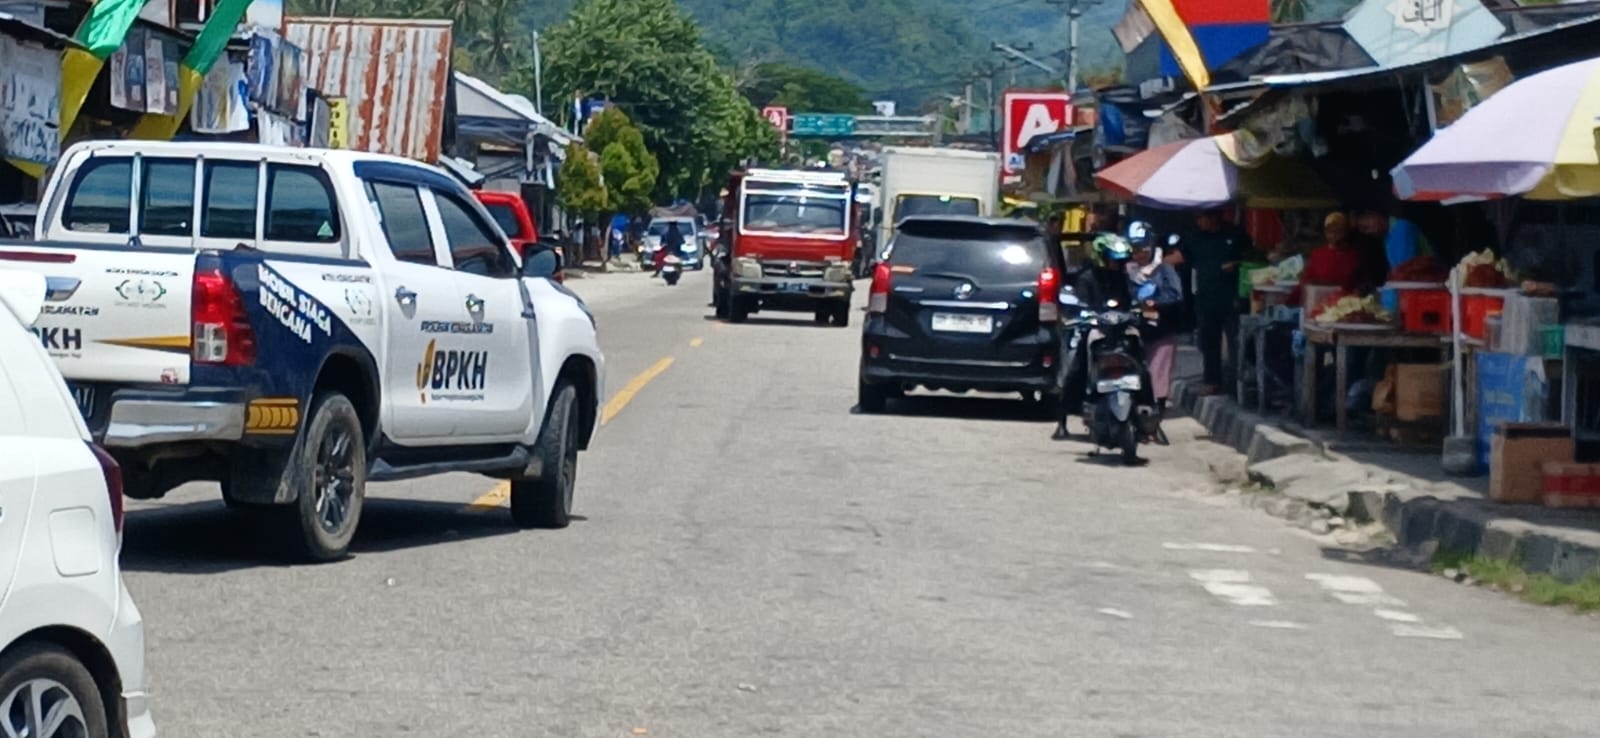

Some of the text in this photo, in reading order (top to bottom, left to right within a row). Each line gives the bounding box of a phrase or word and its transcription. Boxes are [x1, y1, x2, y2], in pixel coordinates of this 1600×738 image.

[257, 263, 332, 337] MOBIL SIAGA
[259, 285, 312, 344] BENCANA
[32, 327, 82, 350] KH
[431, 350, 488, 390] BPKH
